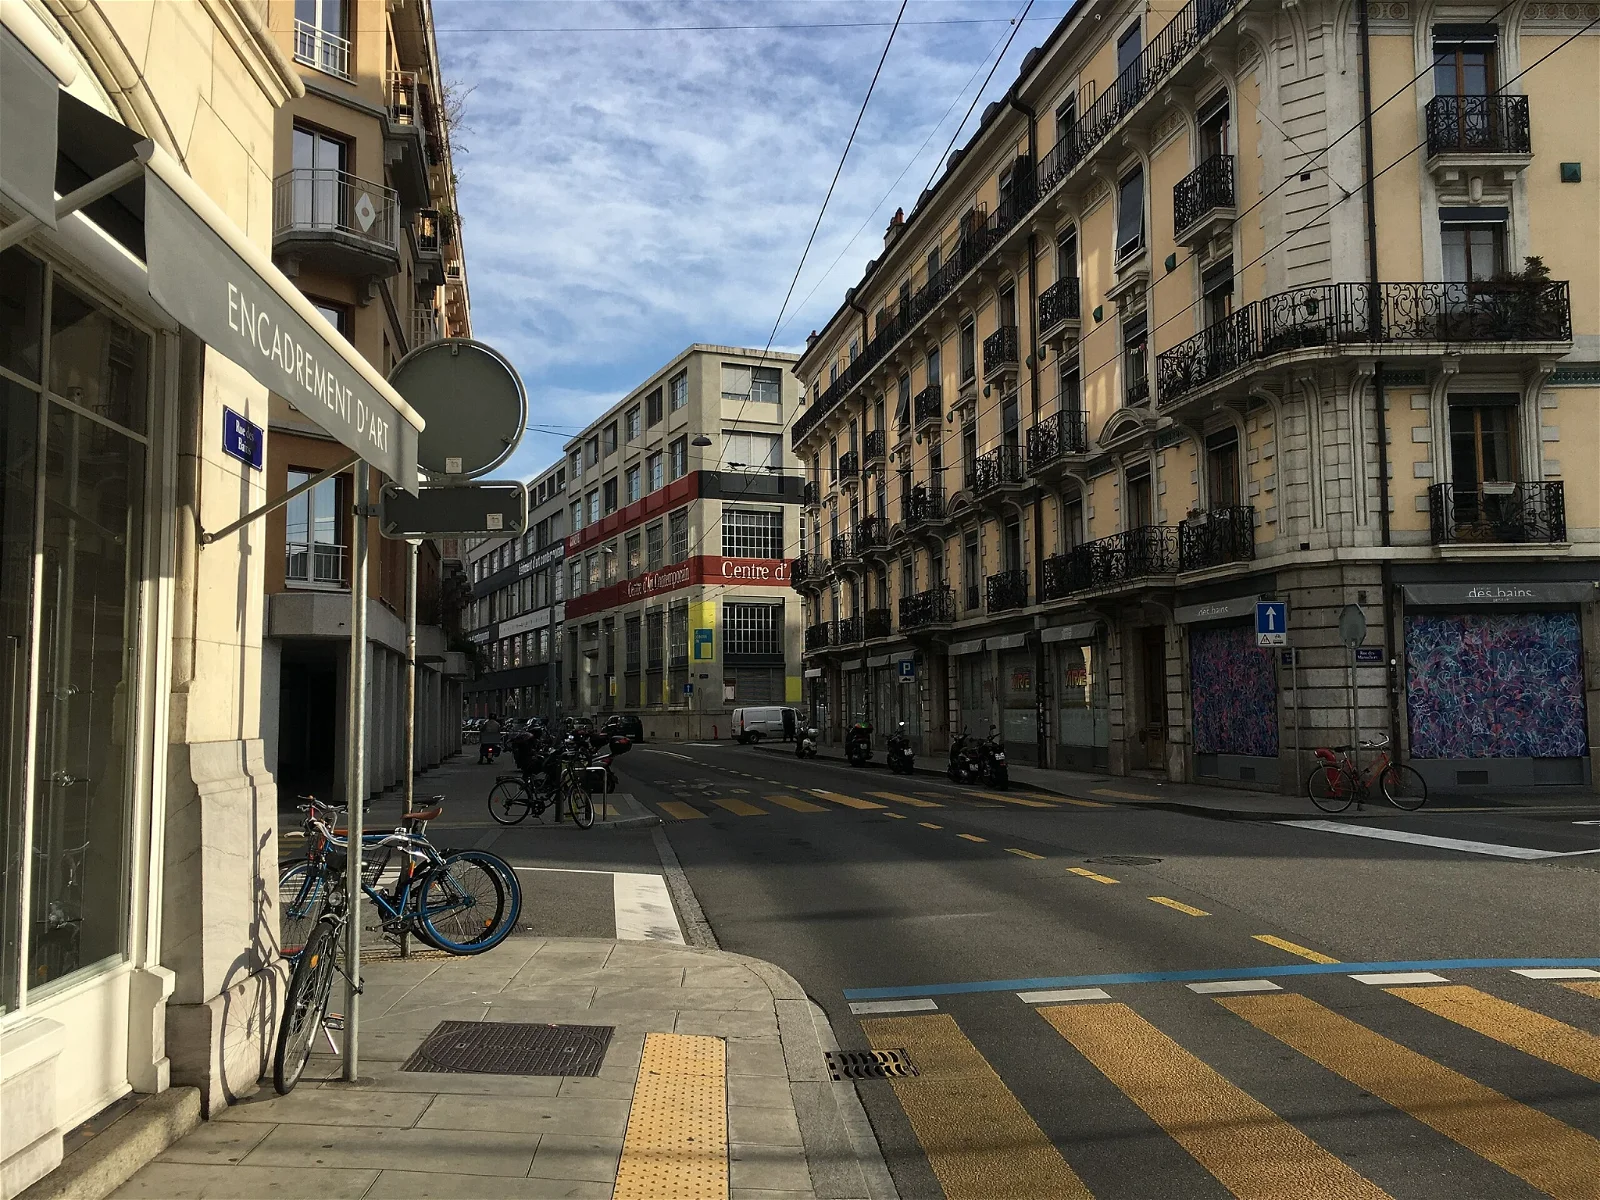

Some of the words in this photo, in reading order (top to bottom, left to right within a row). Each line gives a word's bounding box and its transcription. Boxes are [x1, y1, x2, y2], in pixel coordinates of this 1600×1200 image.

[227, 281, 353, 425] ENCADREMENT
[357, 398, 390, 455] D'ART
[236, 419, 246, 437] Rue
[245, 426, 255, 442] des
[238, 437, 252, 456] Bains
[721, 560, 771, 580] Centre
[774, 563, 792, 581] d'
[1468, 586, 1492, 598] des
[1497, 586, 1532, 598] bains
[903, 662, 911, 675] P
